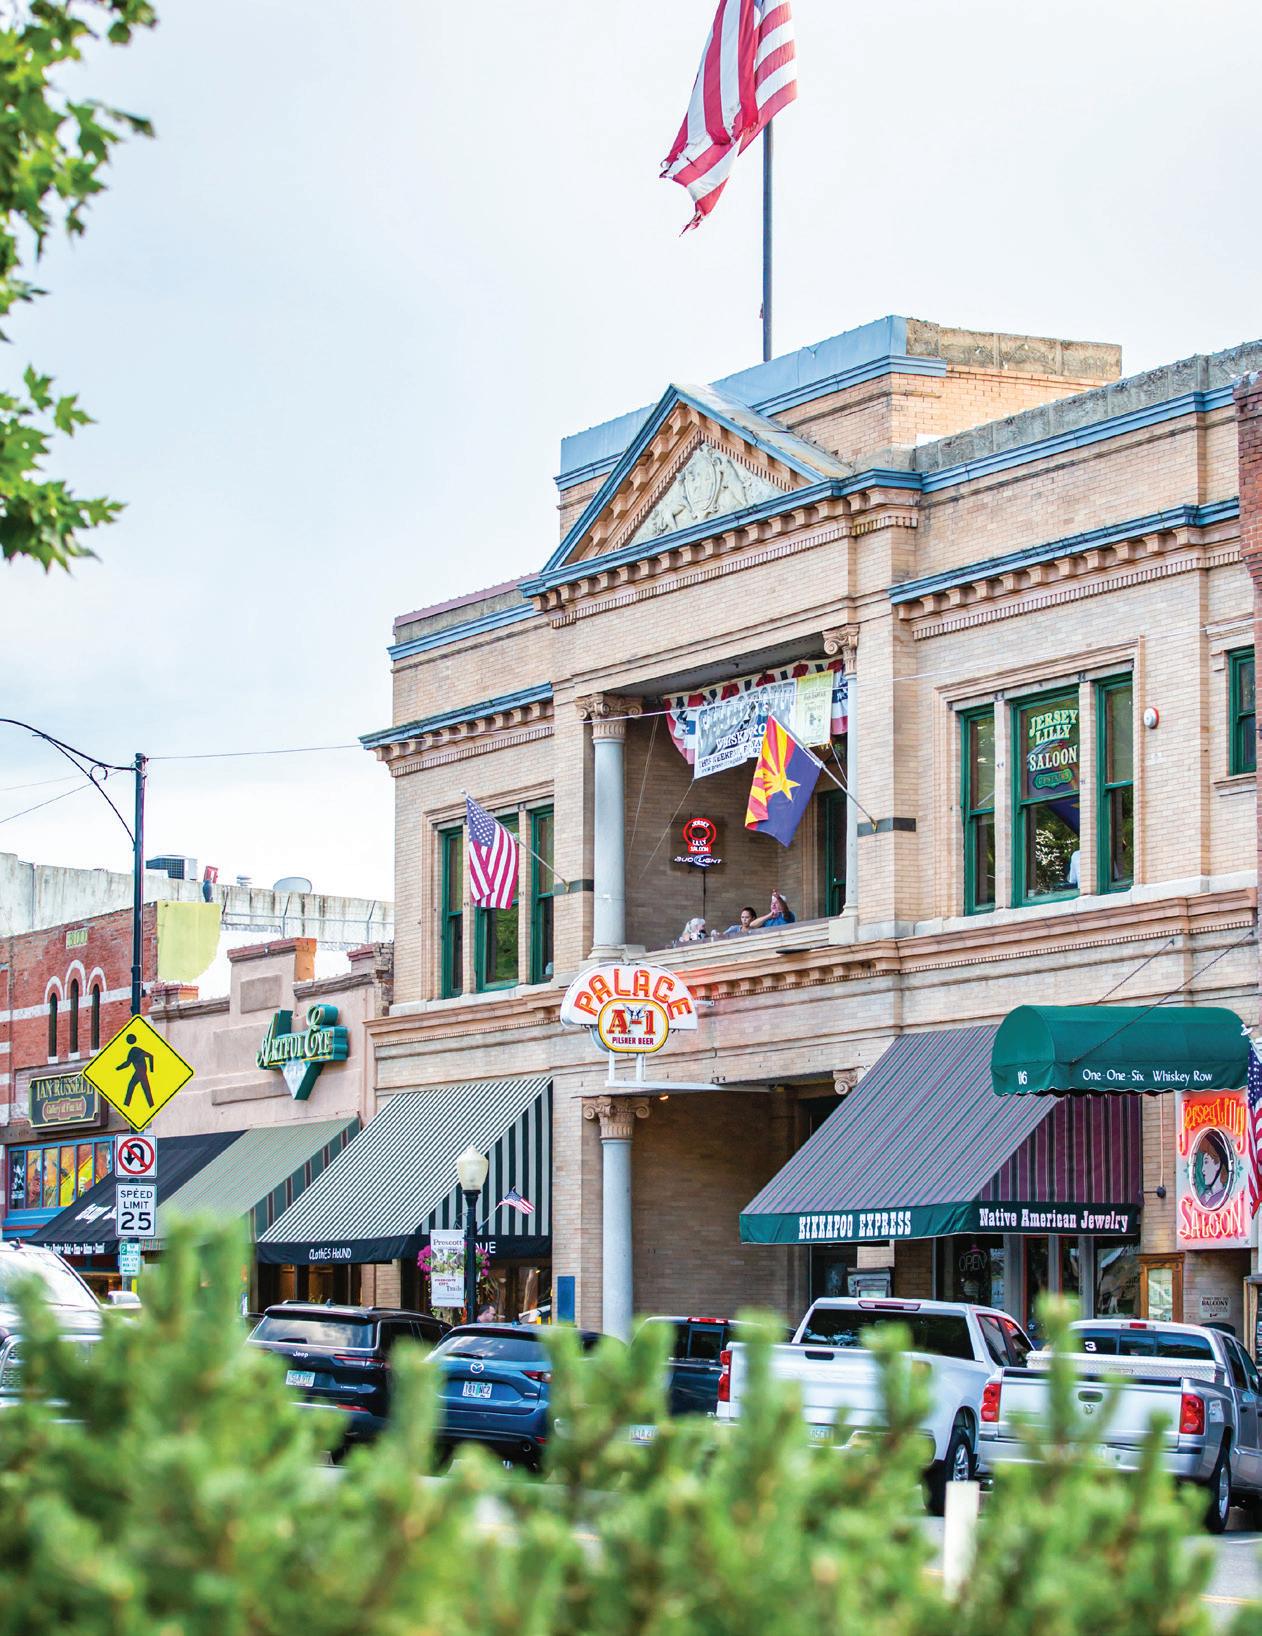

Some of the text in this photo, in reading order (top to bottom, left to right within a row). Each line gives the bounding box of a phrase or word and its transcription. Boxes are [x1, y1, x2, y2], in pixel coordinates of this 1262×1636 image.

[751, 722, 767, 738] RO
[1029, 709, 1078, 737] JERSEY
[1035, 724, 1072, 746] LILLY
[1029, 745, 1078, 772] SALOON
[573, 968, 693, 1021] PALACE
[606, 1009, 657, 1036] A-1
[611, 1036, 654, 1045] PILSNER BEER
[1152, 1070, 1190, 1086] Whiskey
[1192, 1071, 1213, 1082] Row
[120, 1190, 153, 1199] SPEED
[123, 1201, 149, 1209] LIMIT
[1176, 1189, 1246, 1241] SALOON
[120, 1212, 152, 1231] 25
[858, 1211, 912, 1237] EXPRESS
[979, 1208, 1129, 1233] Native American Jewelry
[958, 1254, 987, 1273] OPEN
[1084, 1341, 1097, 1352] 3
